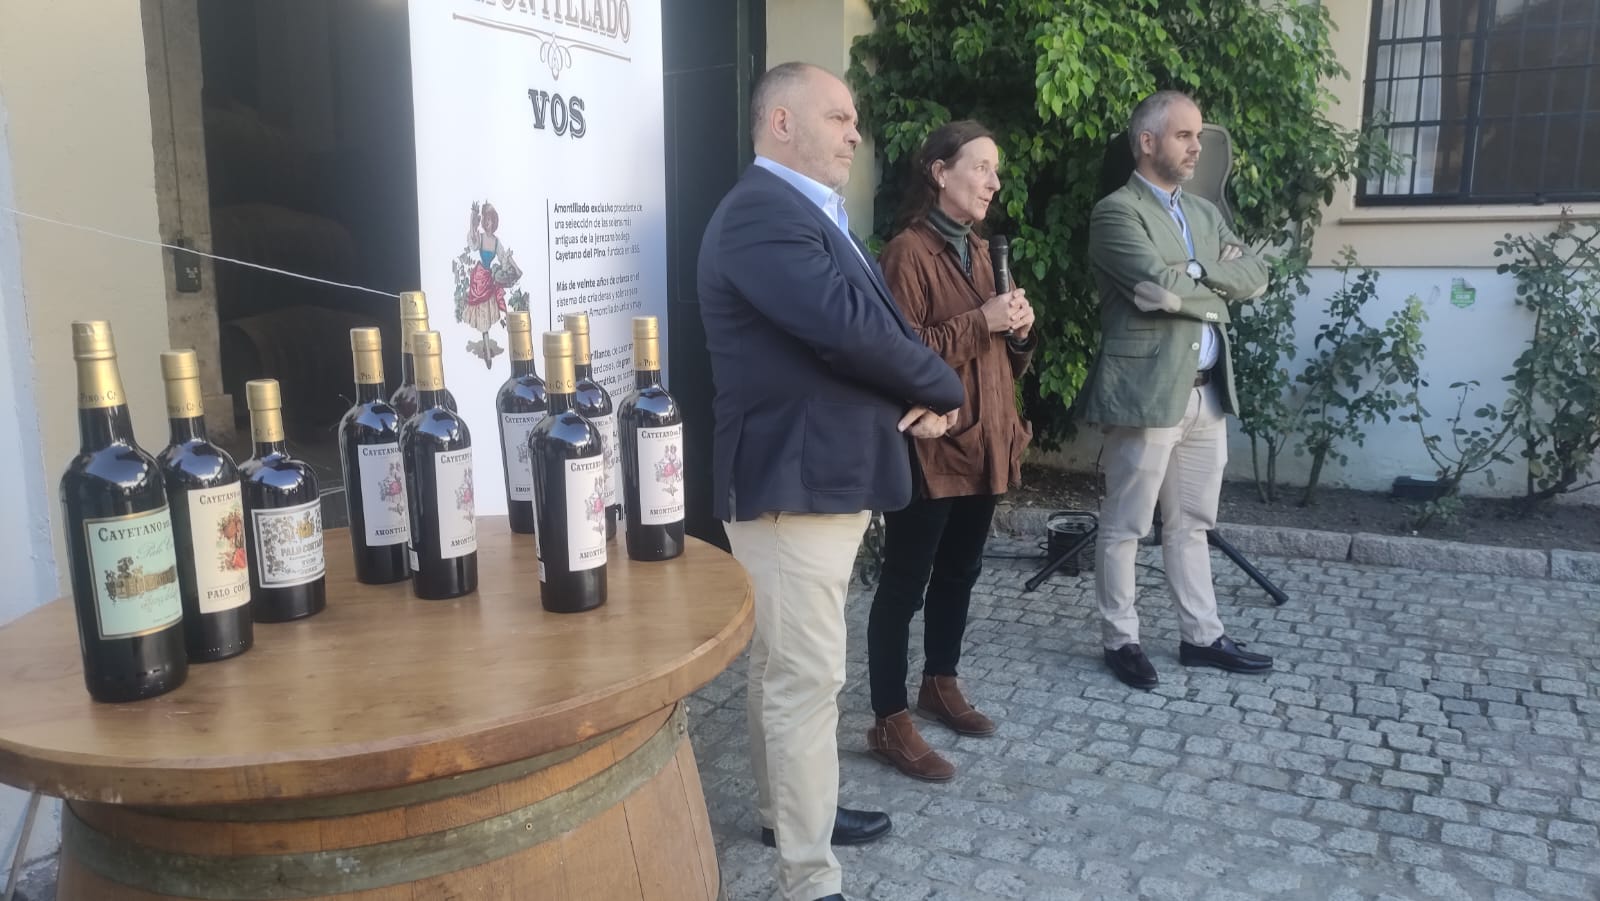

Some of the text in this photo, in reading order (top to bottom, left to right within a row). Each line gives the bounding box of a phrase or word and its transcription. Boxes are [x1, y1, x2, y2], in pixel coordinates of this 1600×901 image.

[473, 0, 631, 43] ILLADO
[528, 88, 586, 139] VOS
[554, 202, 589, 213] Amontillado
[591, 202, 613, 213] exclusivo
[555, 219, 564, 229] una
[566, 217, 592, 228] selección
[594, 217, 600, 227] de
[555, 233, 578, 247] antiguas
[580, 232, 587, 243] de
[589, 232, 593, 242] la
[556, 249, 582, 262] Cayetano
[583, 248, 592, 259] del
[556, 279, 568, 291] Más
[569, 280, 576, 290] de
[577, 278, 595, 289] veinte
[597, 277, 609, 287] años
[557, 295, 578, 308] sistema
[579, 293, 586, 304] de
[590, 349, 612, 360] rillante,
[98, 521, 162, 542] CAYETANO
[207, 587, 231, 600] PALO
